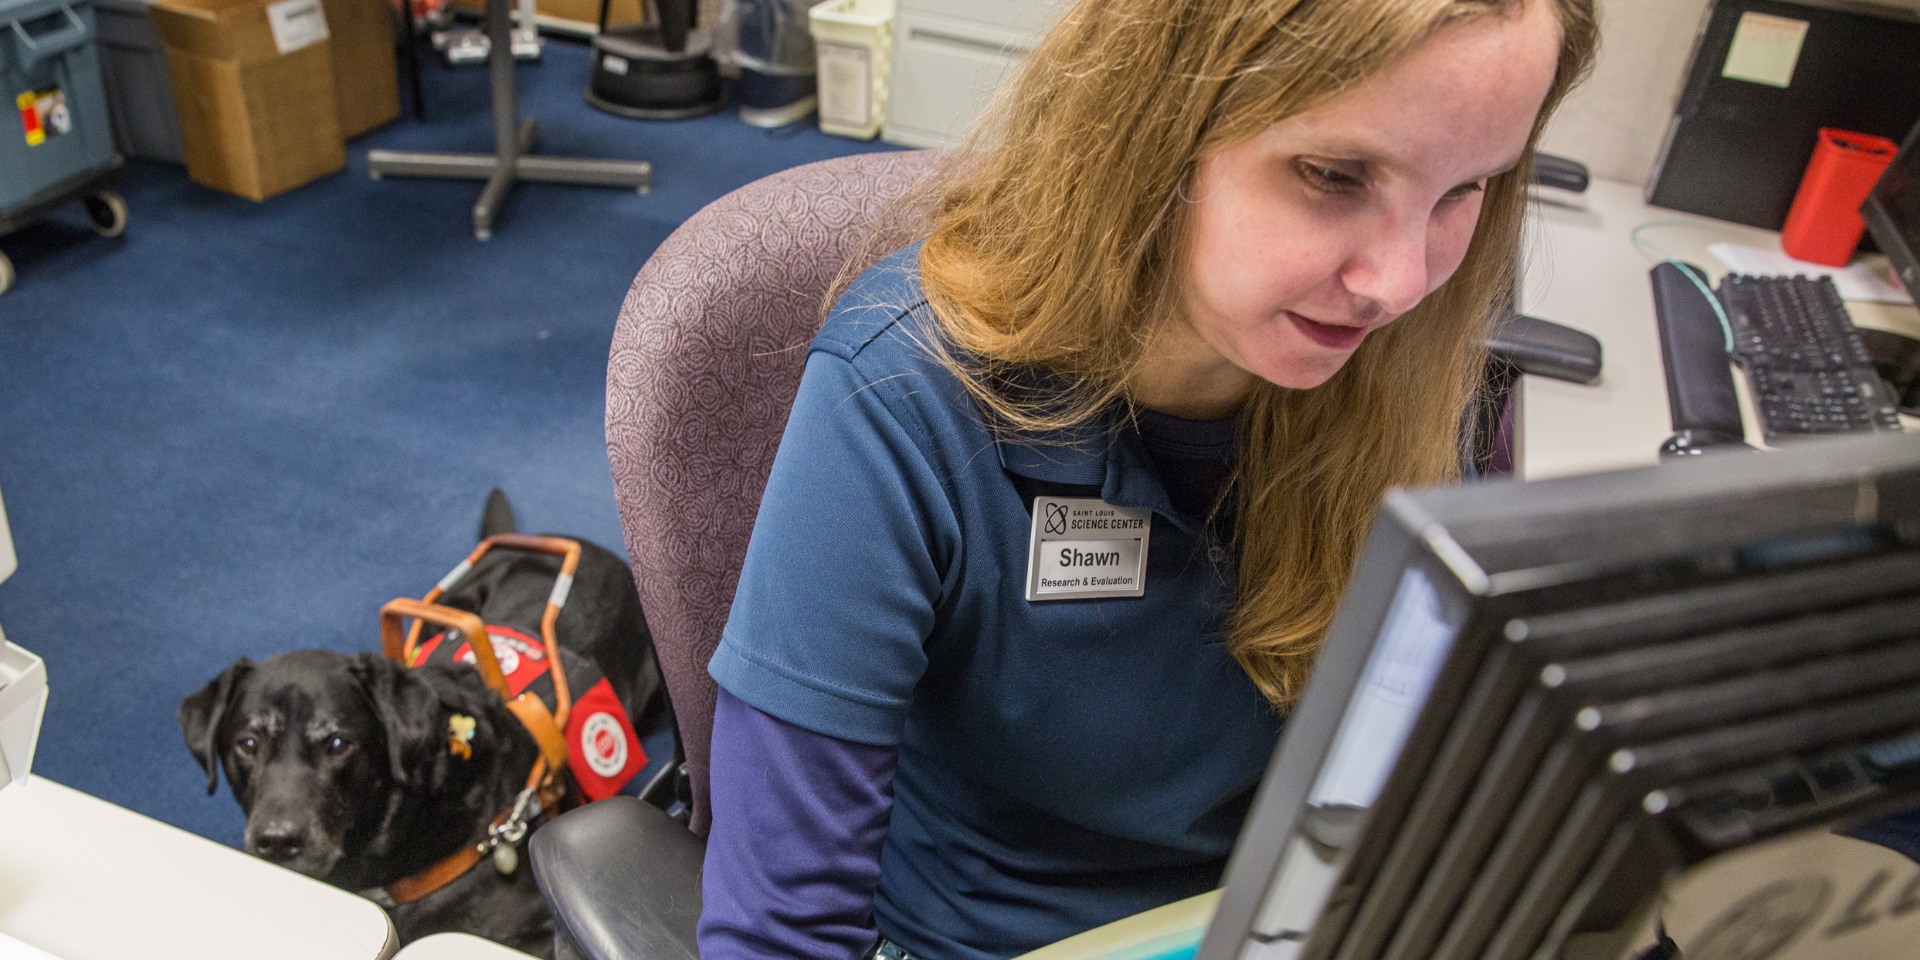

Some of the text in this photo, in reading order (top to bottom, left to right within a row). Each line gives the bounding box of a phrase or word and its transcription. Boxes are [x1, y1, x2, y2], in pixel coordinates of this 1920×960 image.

[1071, 519, 1144, 530] SCIENCE CENTER
[1059, 548, 1120, 567] Shawn
[1041, 576, 1133, 587] Research & Evaluation
